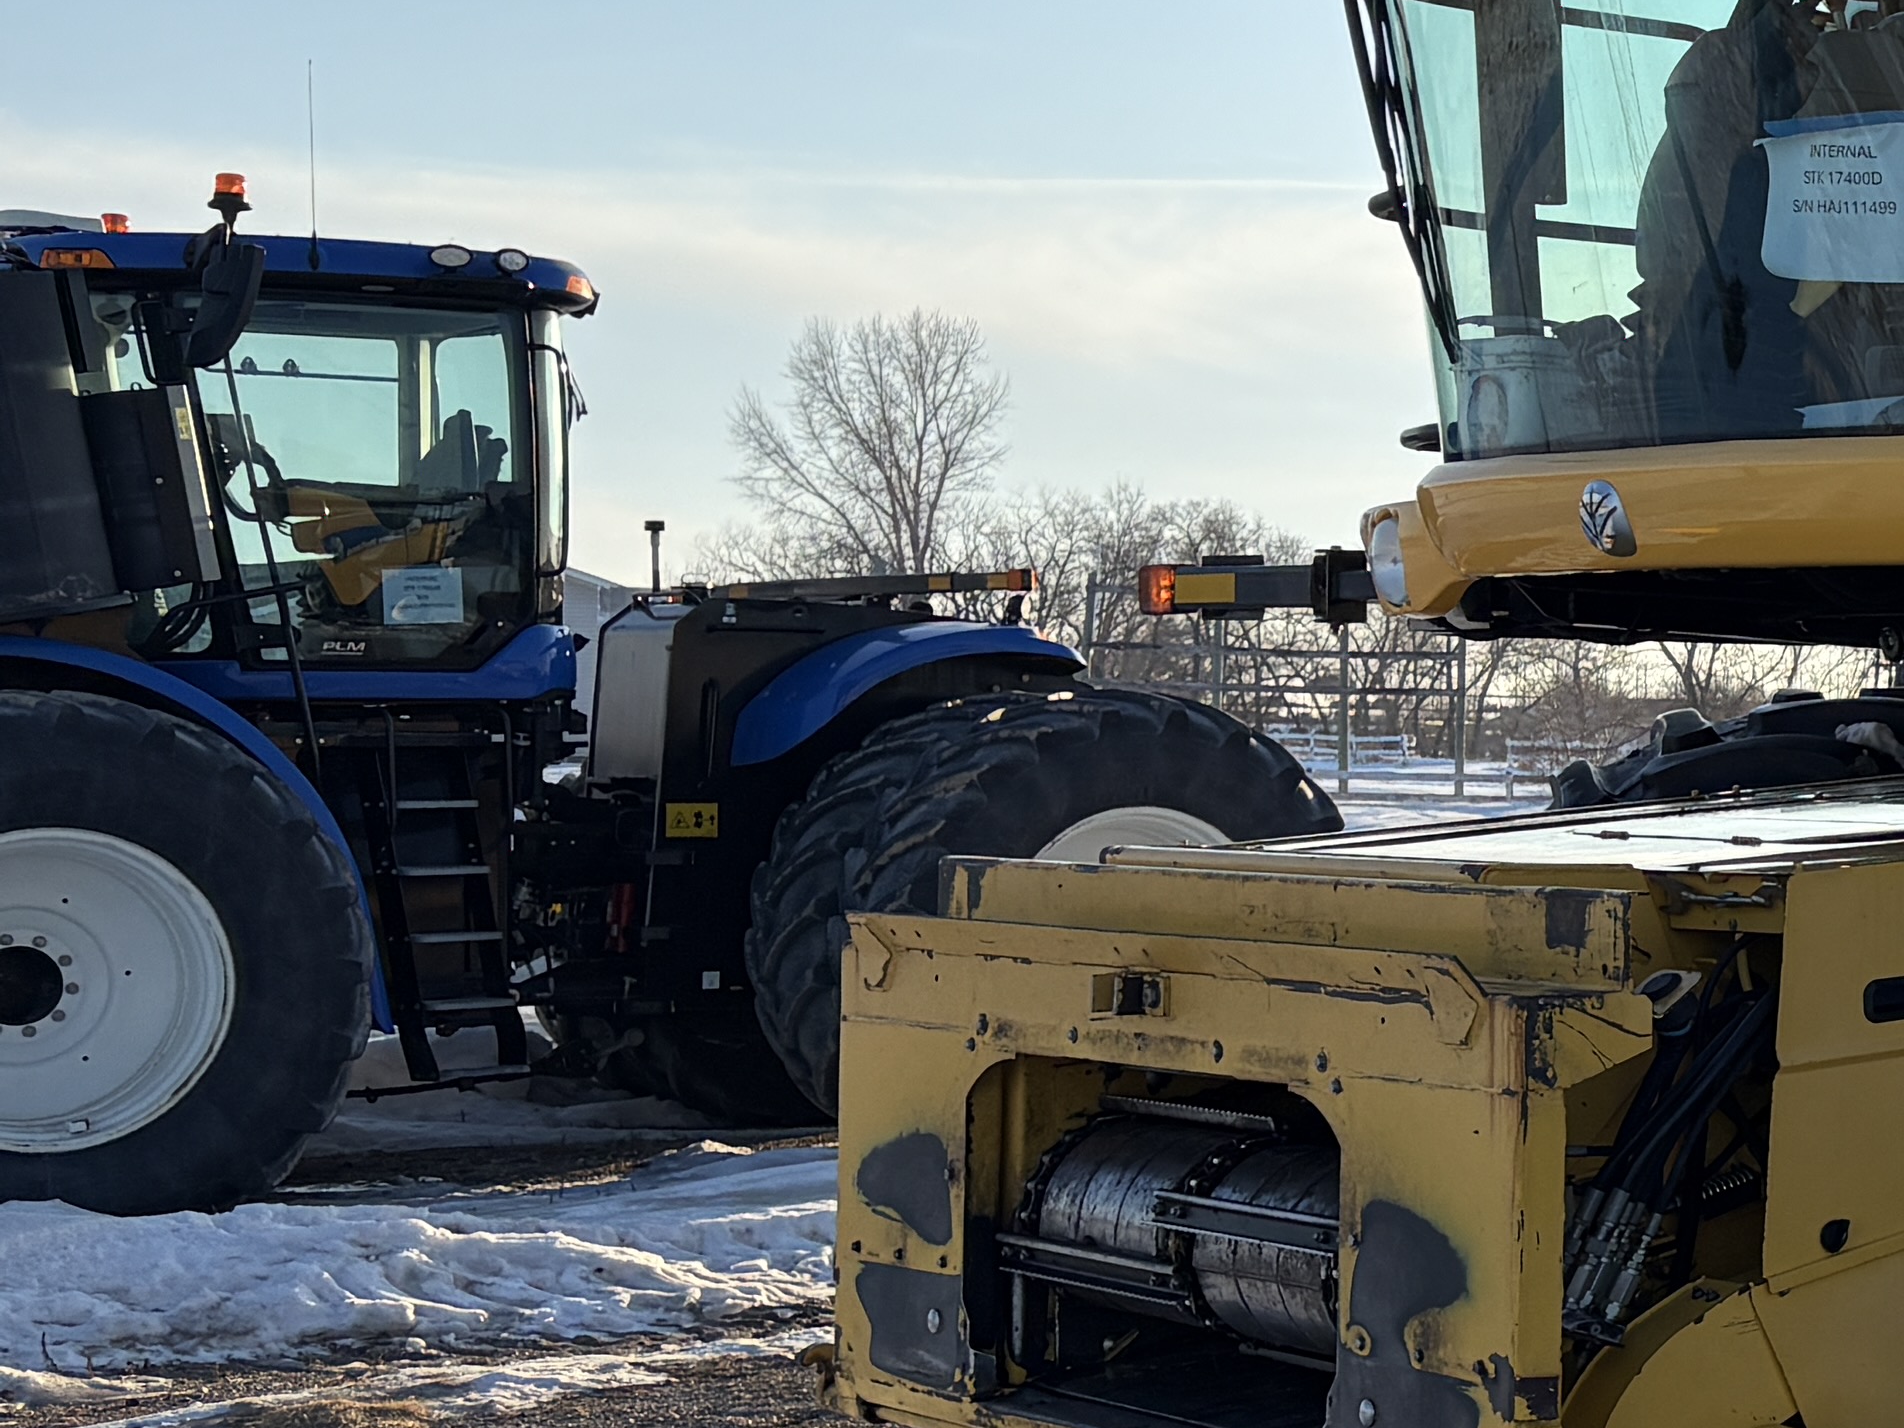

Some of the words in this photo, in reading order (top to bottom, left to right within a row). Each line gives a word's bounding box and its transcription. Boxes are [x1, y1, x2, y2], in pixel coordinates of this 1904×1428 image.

[1810, 144, 1877, 159] INTERNAL
[1803, 170, 1825, 185] STK
[1829, 171, 1883, 185] 17400D
[1792, 200, 1814, 214] S/N
[1817, 200, 1897, 215] HAJ111499
[322, 641, 367, 652] PLM
